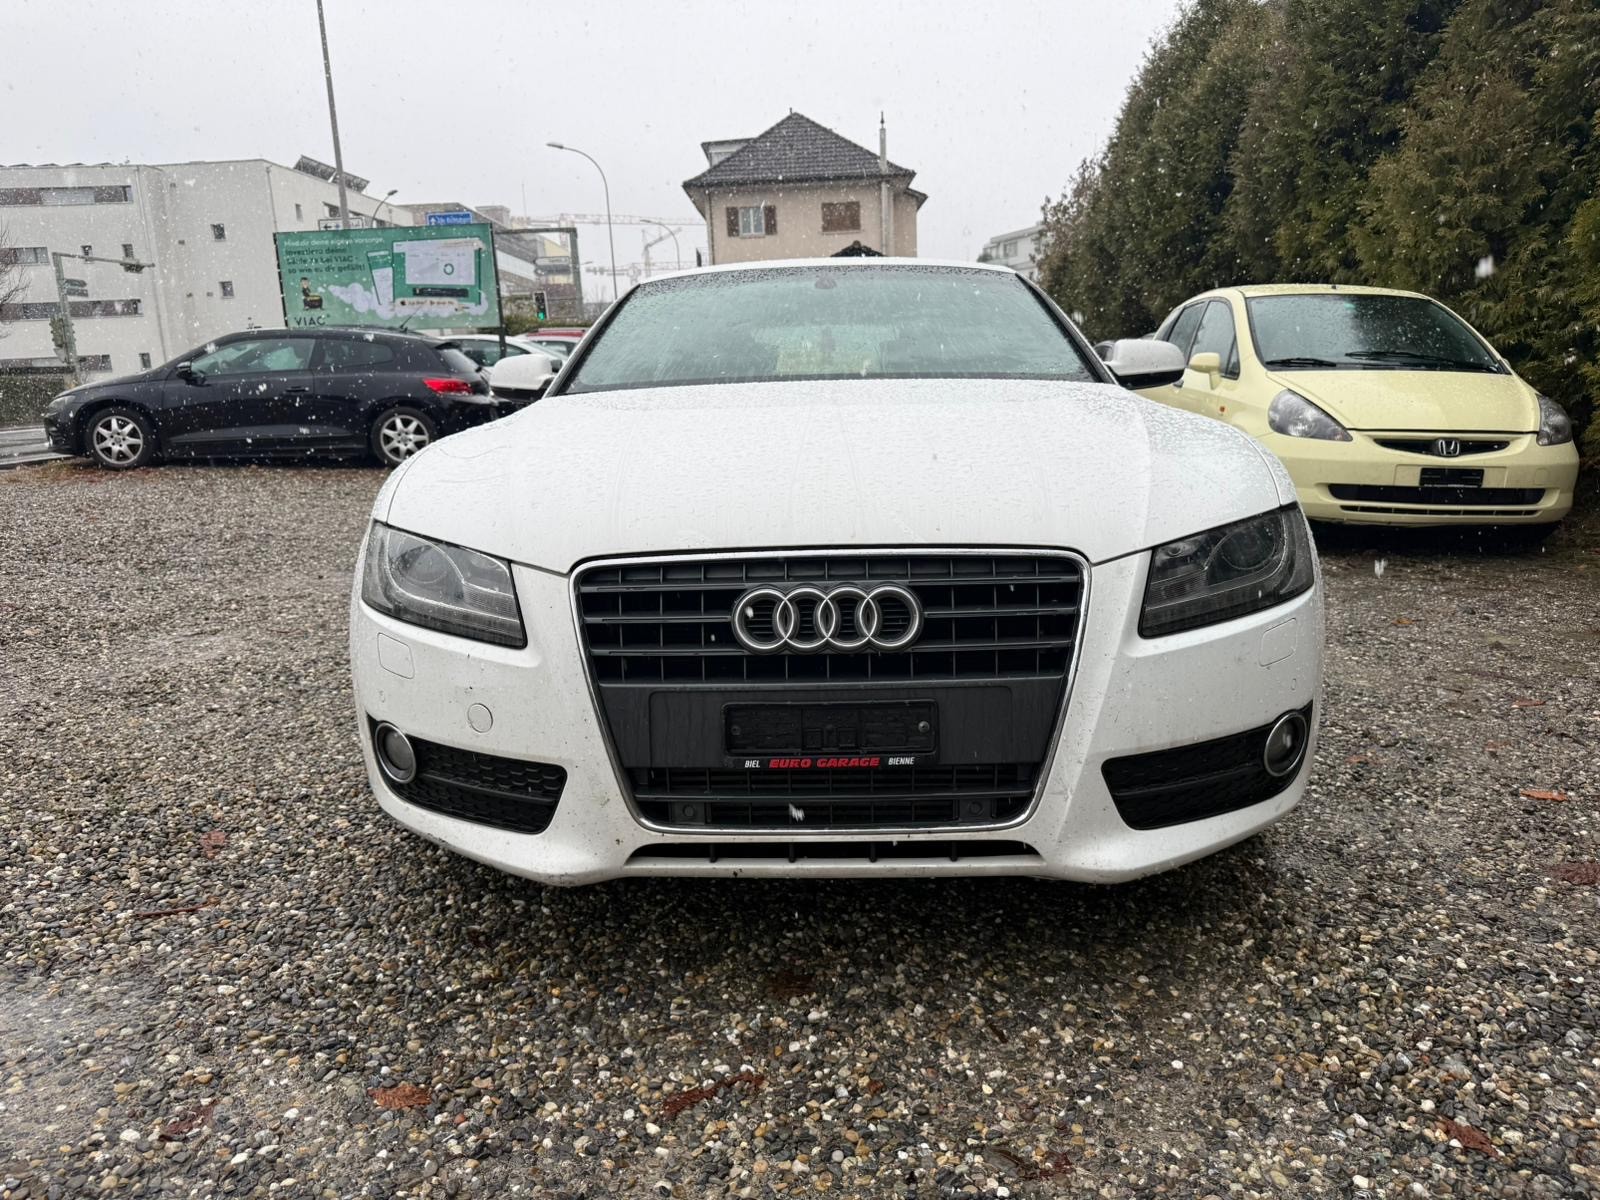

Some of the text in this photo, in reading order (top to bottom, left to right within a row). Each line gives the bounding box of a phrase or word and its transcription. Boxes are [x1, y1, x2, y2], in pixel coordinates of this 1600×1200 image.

[294, 316, 326, 326] VIAC
[744, 756, 916, 768] BIEL EURO GARAGE BIENNE
